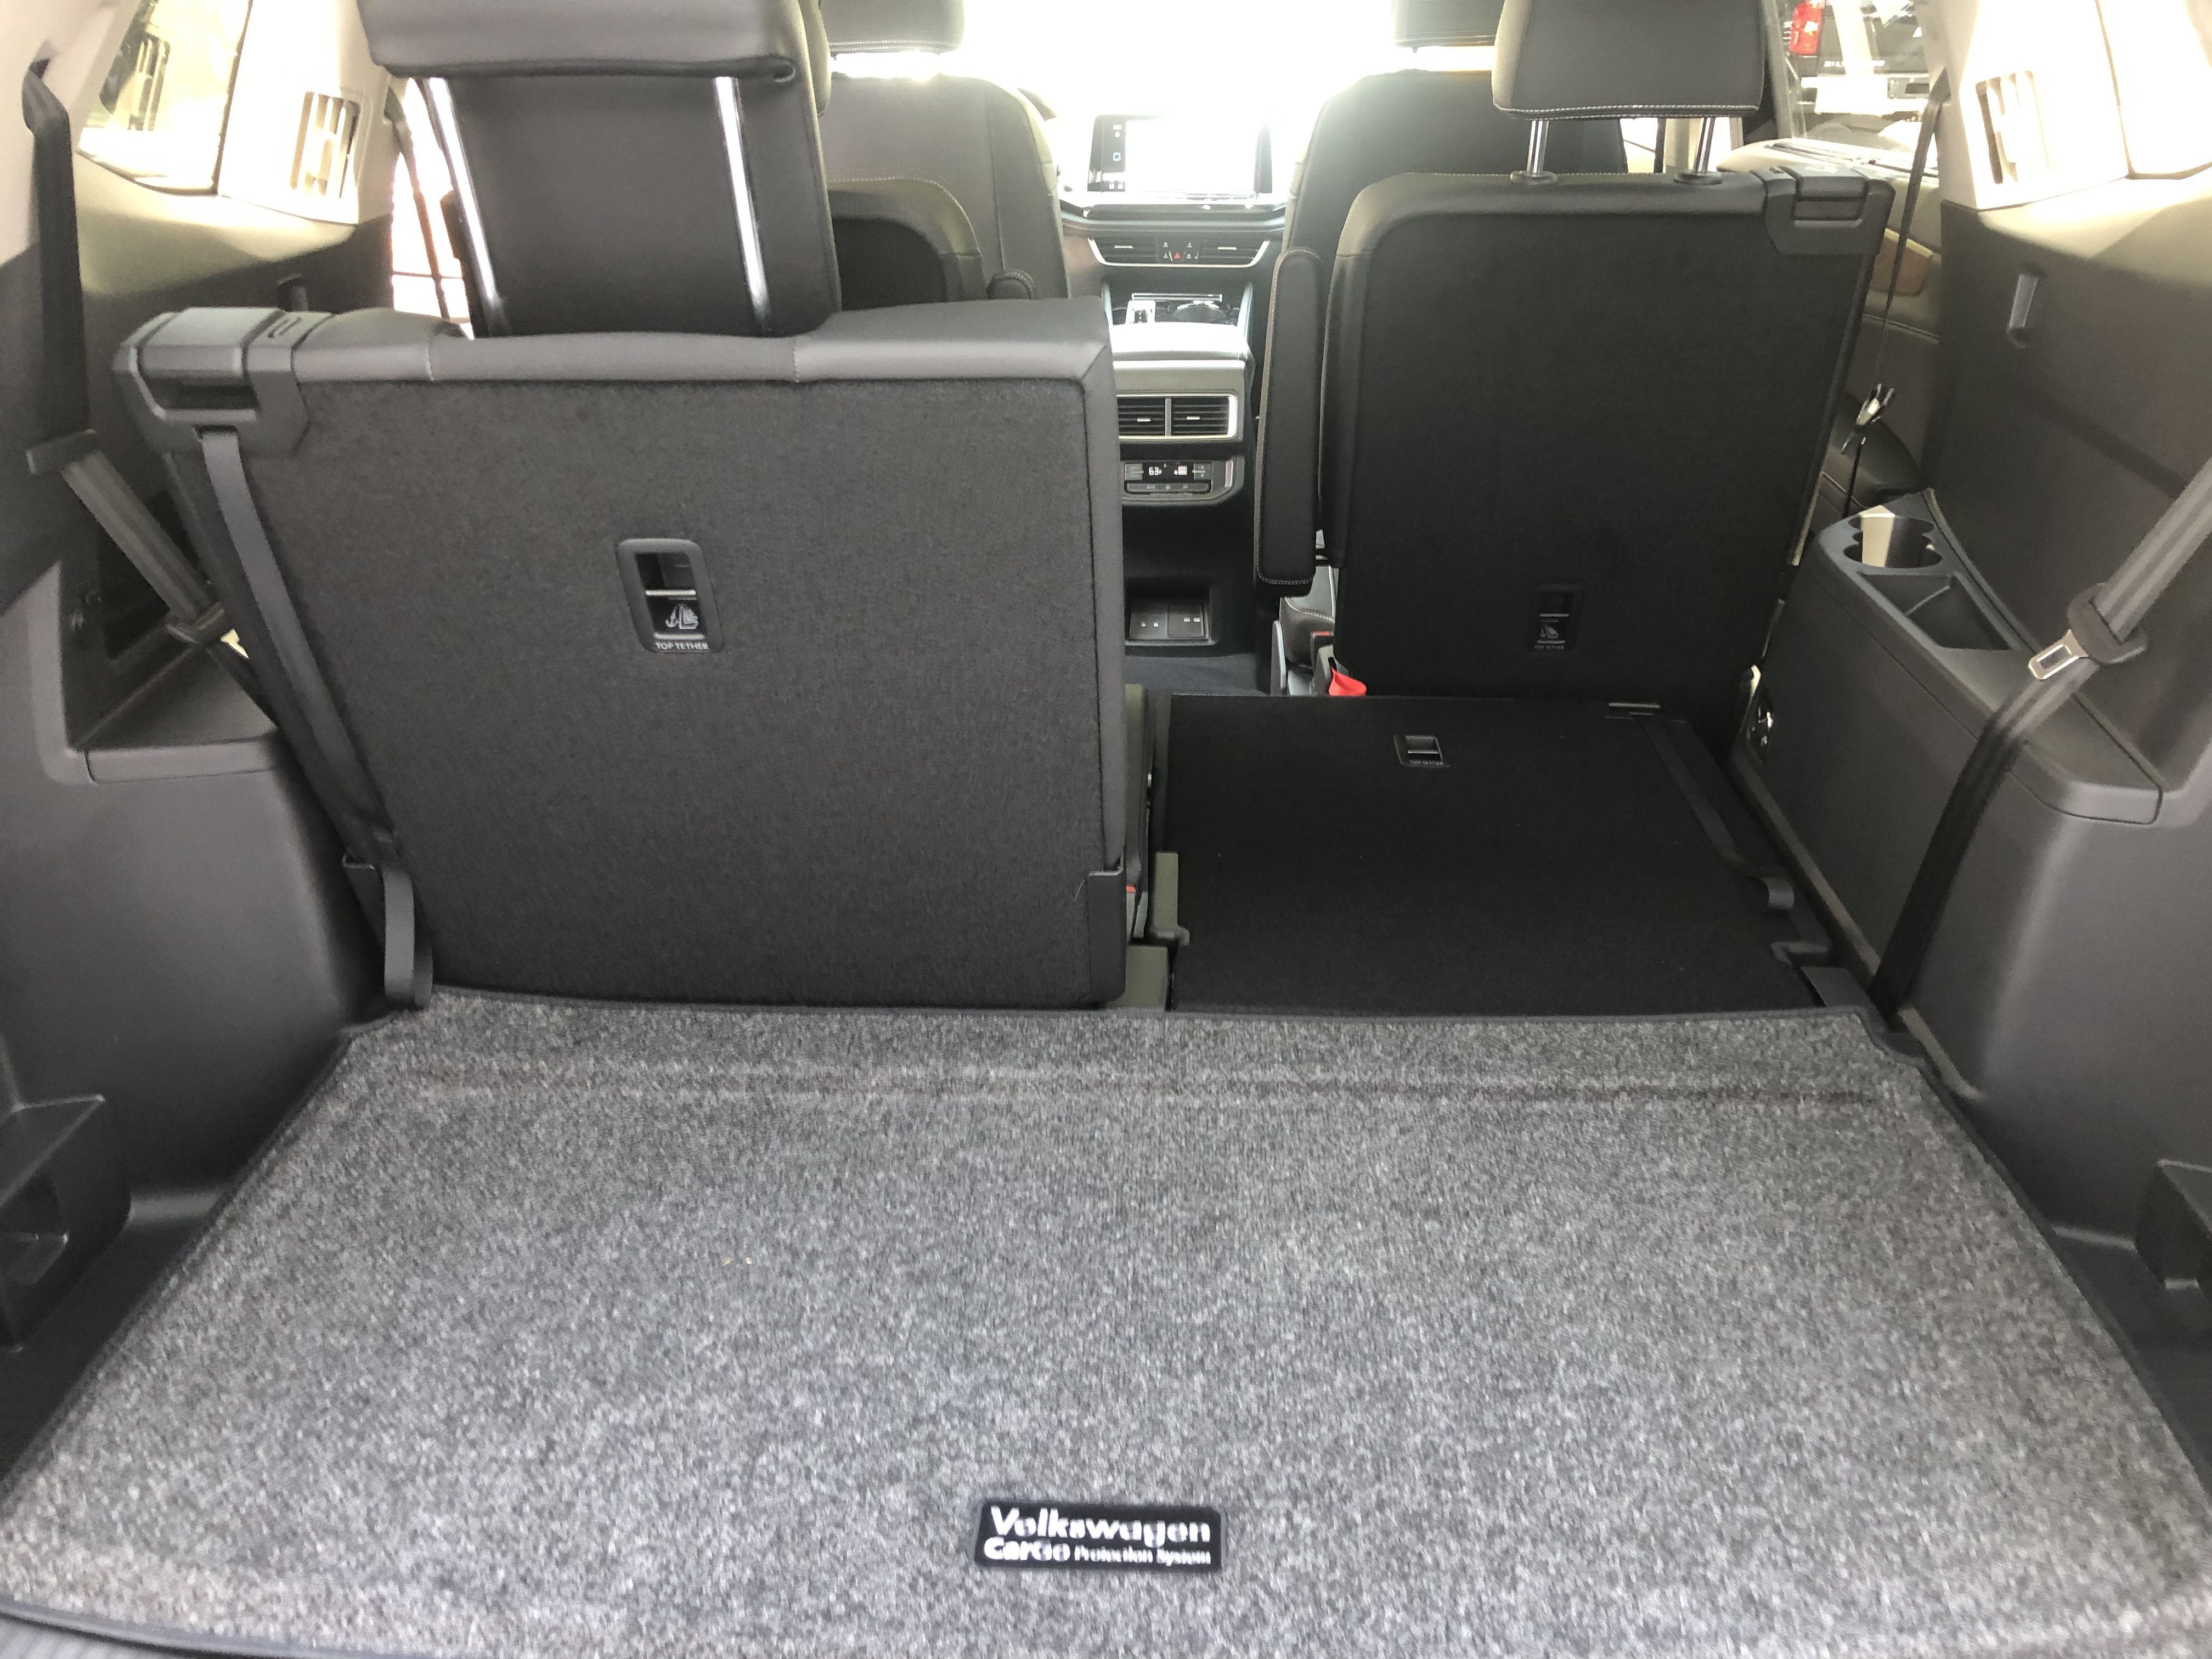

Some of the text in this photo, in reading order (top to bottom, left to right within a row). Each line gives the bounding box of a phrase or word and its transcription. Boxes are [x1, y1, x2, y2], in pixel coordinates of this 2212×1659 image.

[654, 641, 709, 650] TOP TETHER
[990, 1505, 1210, 1548] Volkswagen
